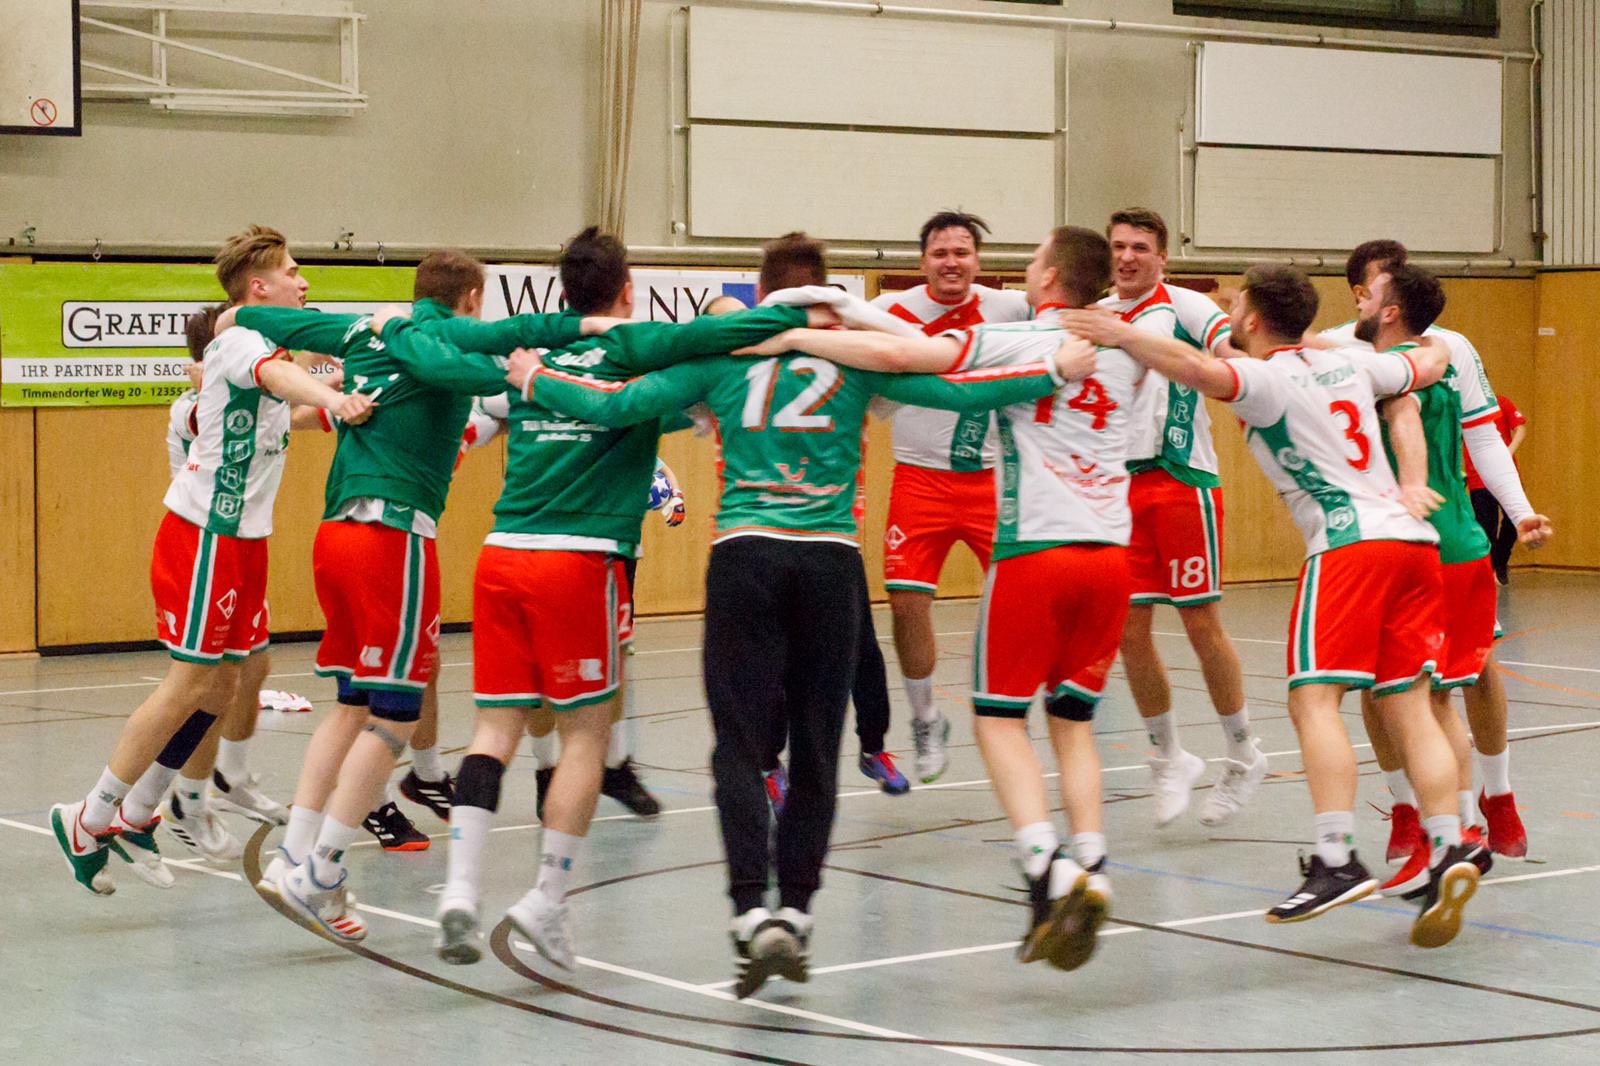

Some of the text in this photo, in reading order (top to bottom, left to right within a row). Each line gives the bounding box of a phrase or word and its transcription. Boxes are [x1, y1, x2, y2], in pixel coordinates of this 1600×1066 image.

[21, 365, 49, 377] IHR
[54, 364, 125, 377] PARTNER
[130, 364, 147, 376] IN
[22, 387, 100, 398] Timmendorfer
[102, 387, 125, 399] Weg
[128, 387, 141, 396] 20
[742, 357, 844, 432] 12
[1329, 399, 1371, 474] 3
[1169, 556, 1205, 588] 18
